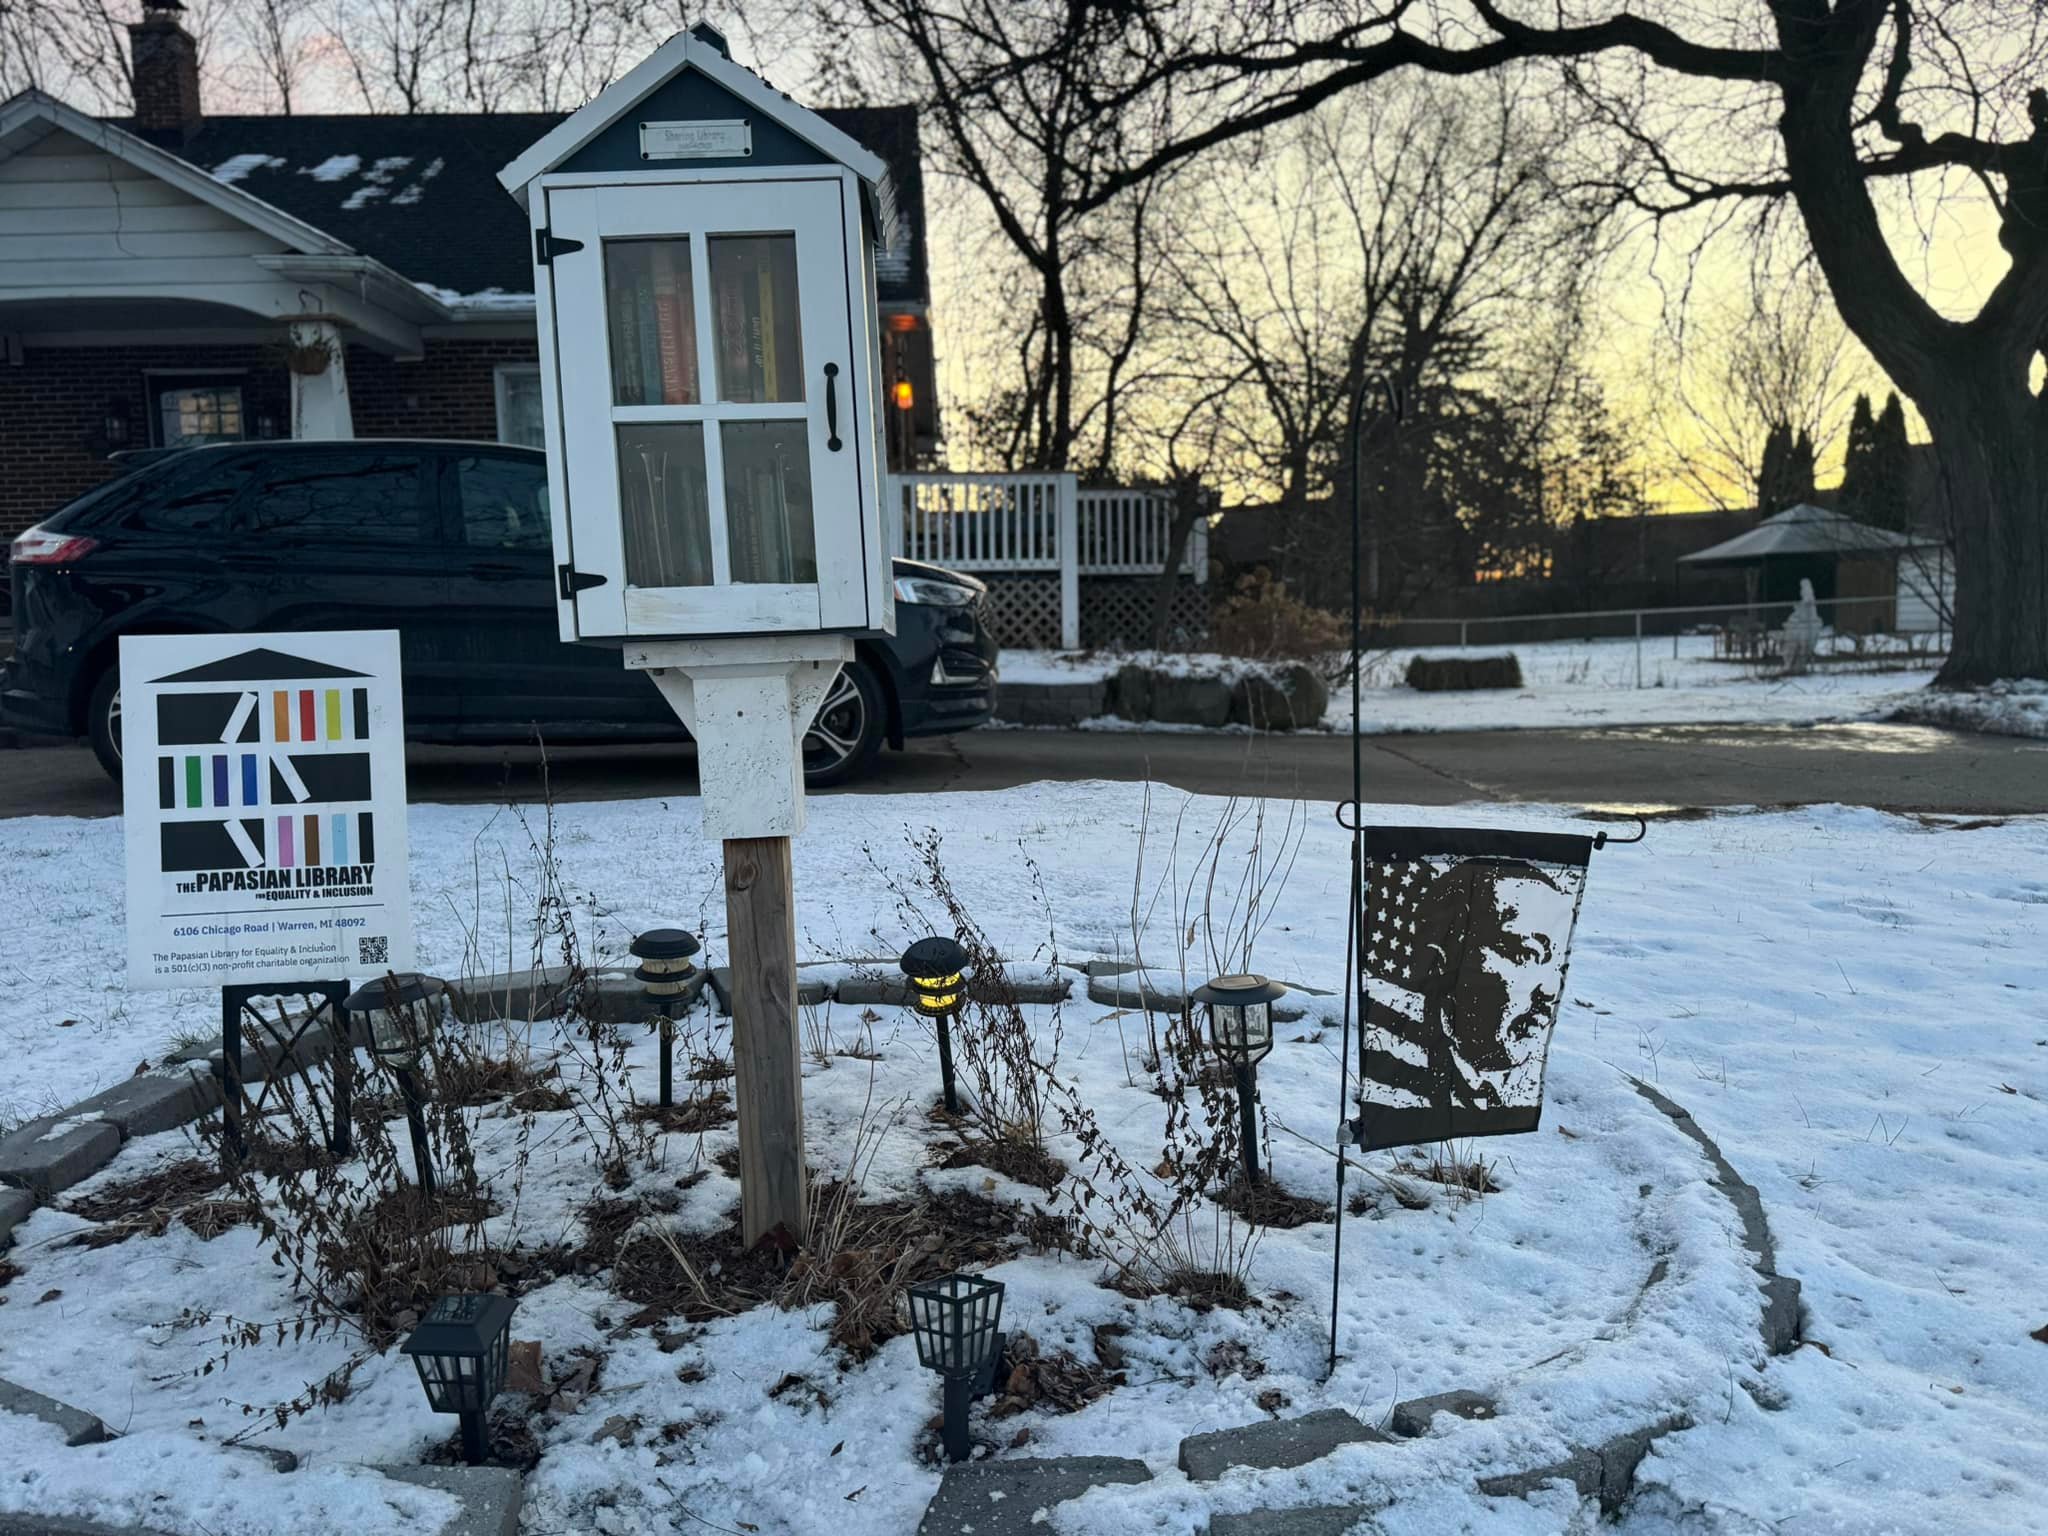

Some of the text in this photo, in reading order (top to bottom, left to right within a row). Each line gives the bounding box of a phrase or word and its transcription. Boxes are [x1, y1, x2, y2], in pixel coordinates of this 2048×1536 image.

[176, 865, 374, 893] THE PAPASIAN LIBRARY
[266, 889, 311, 901] EQUALITY
[313, 890, 320, 898] &
[322, 886, 374, 898] INCLUSION
[173, 926, 199, 936] 6106
[202, 924, 242, 935] Chicago
[244, 922, 269, 932] Road
[277, 921, 317, 931] Warren,
[320, 919, 333, 928] MI
[335, 917, 366, 928] 48092
[152, 943, 336, 962] The Papasian Library for Equality & Inclusion
[155, 966, 162, 974] is
[171, 962, 211, 973] 501(c)(3)
[213, 960, 254, 971] non-profit
[256, 958, 298, 968] charitable
[300, 955, 350, 967] organization
